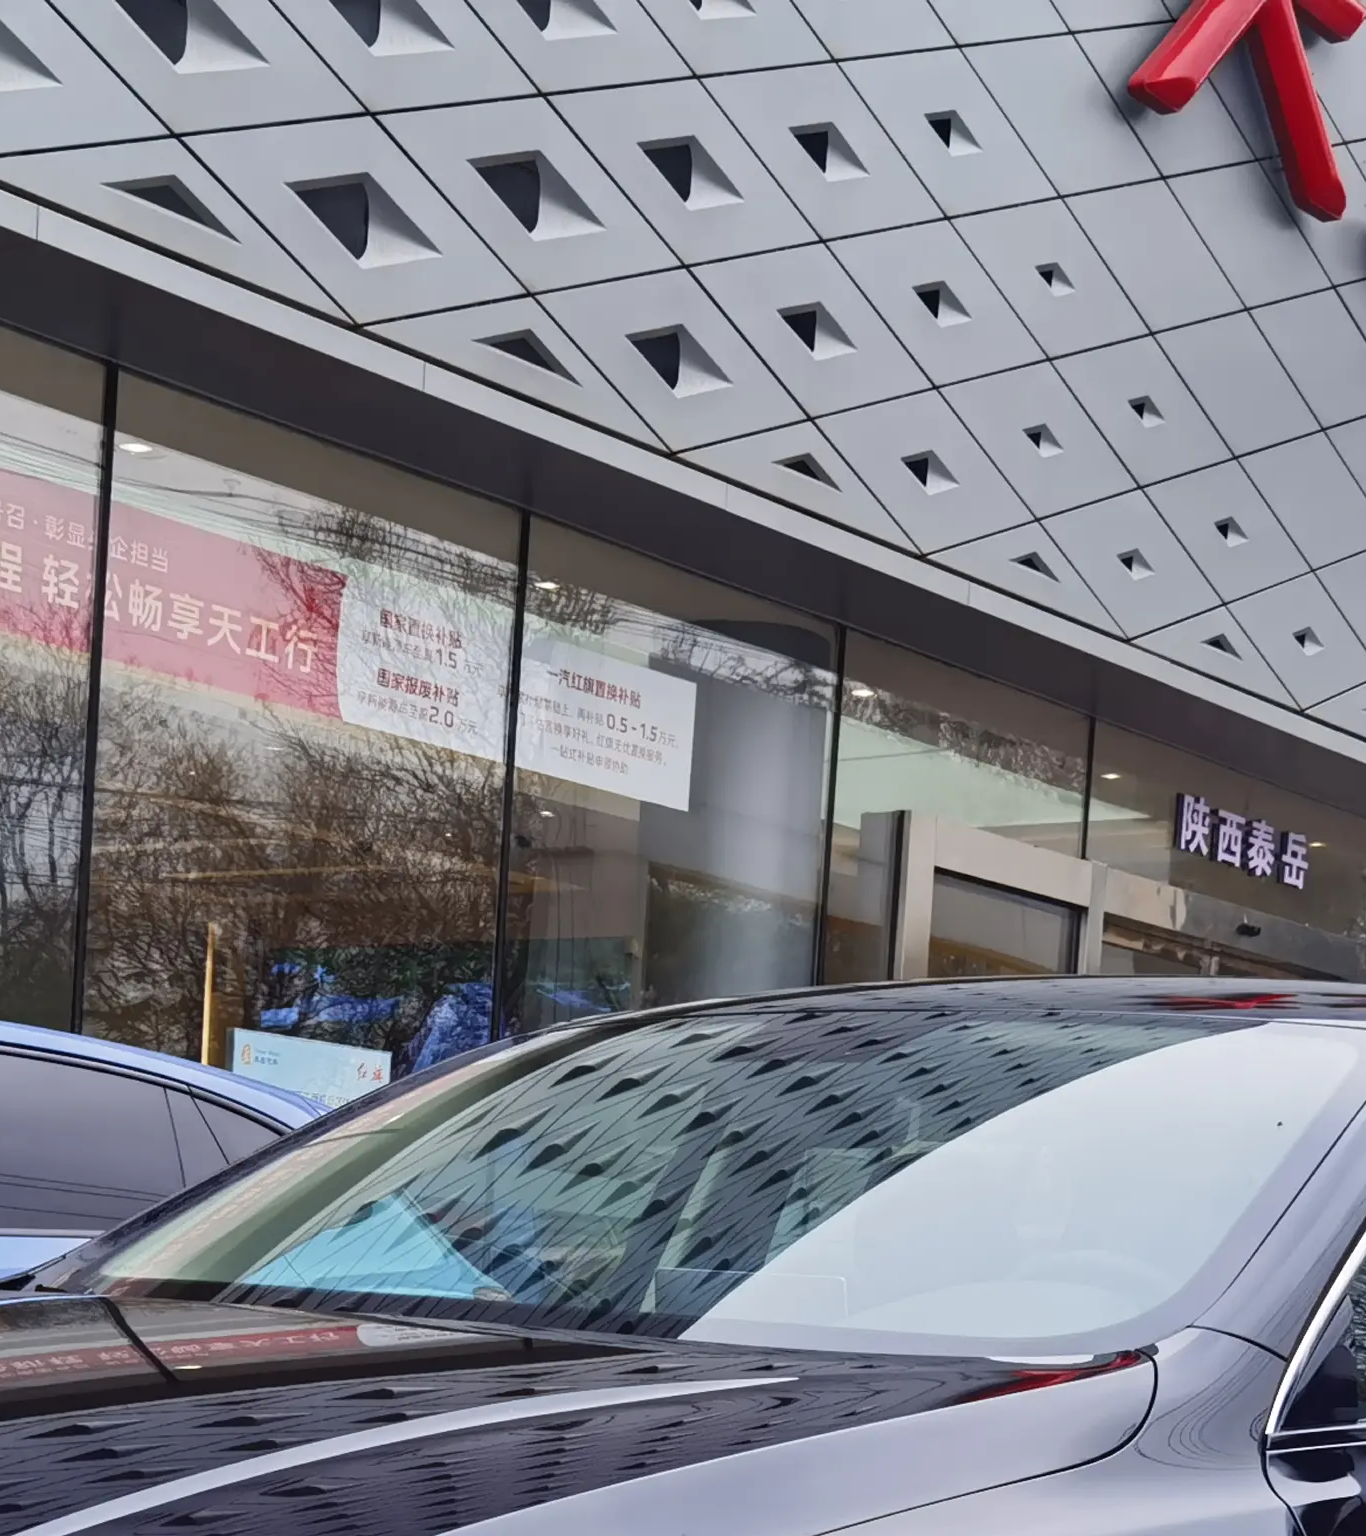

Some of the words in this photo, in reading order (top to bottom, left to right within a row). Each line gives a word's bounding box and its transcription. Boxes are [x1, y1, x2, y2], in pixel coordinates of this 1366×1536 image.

[380, 608, 462, 649] 国家置换补贴
[377, 667, 460, 708] 国家报废补贴
[546, 668, 641, 709] 一汽红旗置换补贴
[1177, 793, 1310, 890] 陕西泰岳
